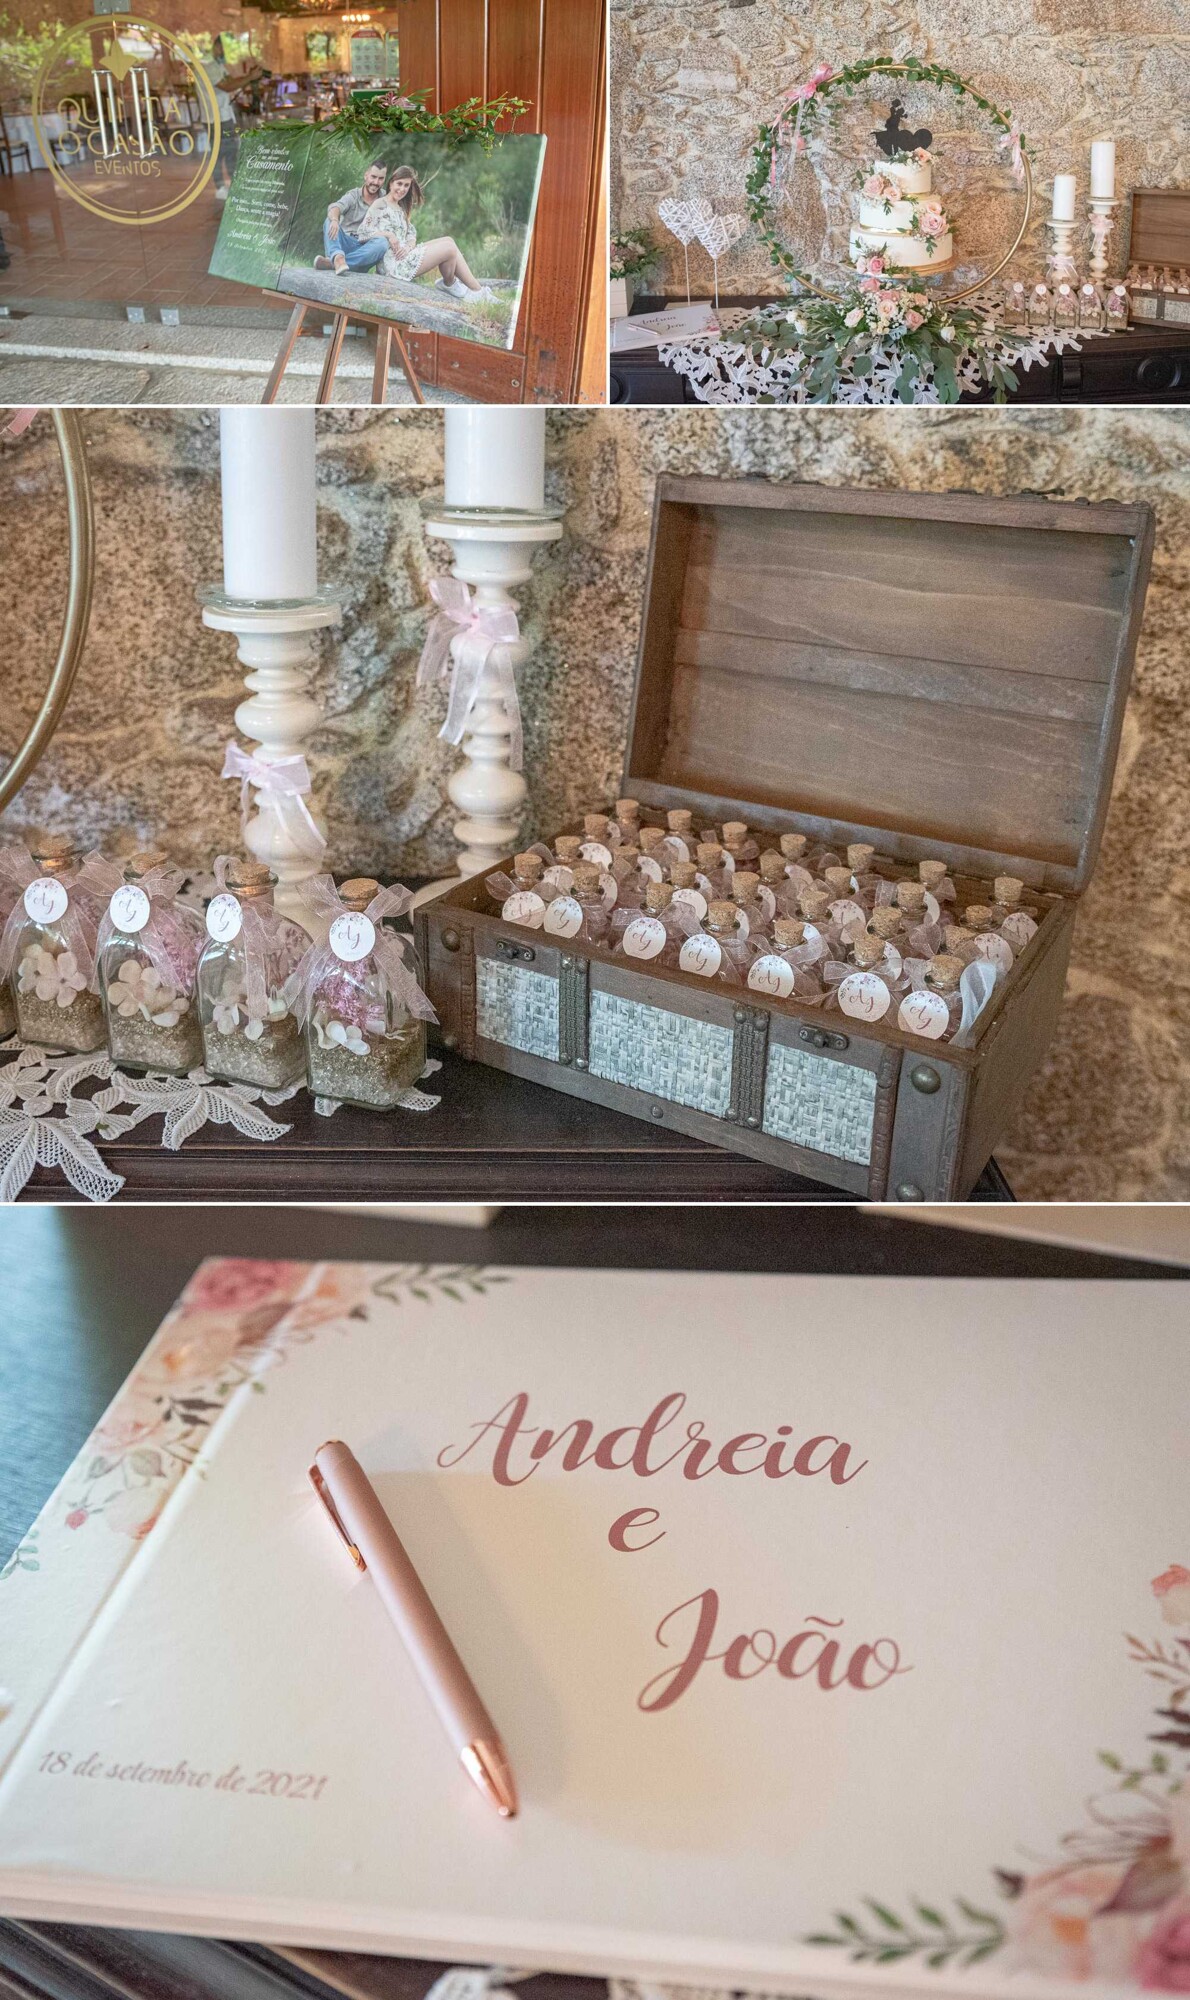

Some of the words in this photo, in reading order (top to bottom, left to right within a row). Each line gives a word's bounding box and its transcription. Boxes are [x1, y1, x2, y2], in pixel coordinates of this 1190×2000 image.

[94, 160, 161, 178] EVENTOS
[246, 155, 294, 172] Casamento
[436, 1391, 869, 1487] Andreia
[608, 1507, 668, 1553] e
[637, 1588, 915, 1714] João
[38, 1750, 73, 1775] 18
[72, 1752, 105, 1779] de
[106, 1760, 211, 1789] setembro
[214, 1765, 247, 1793] de
[247, 1770, 329, 1801] 2021
